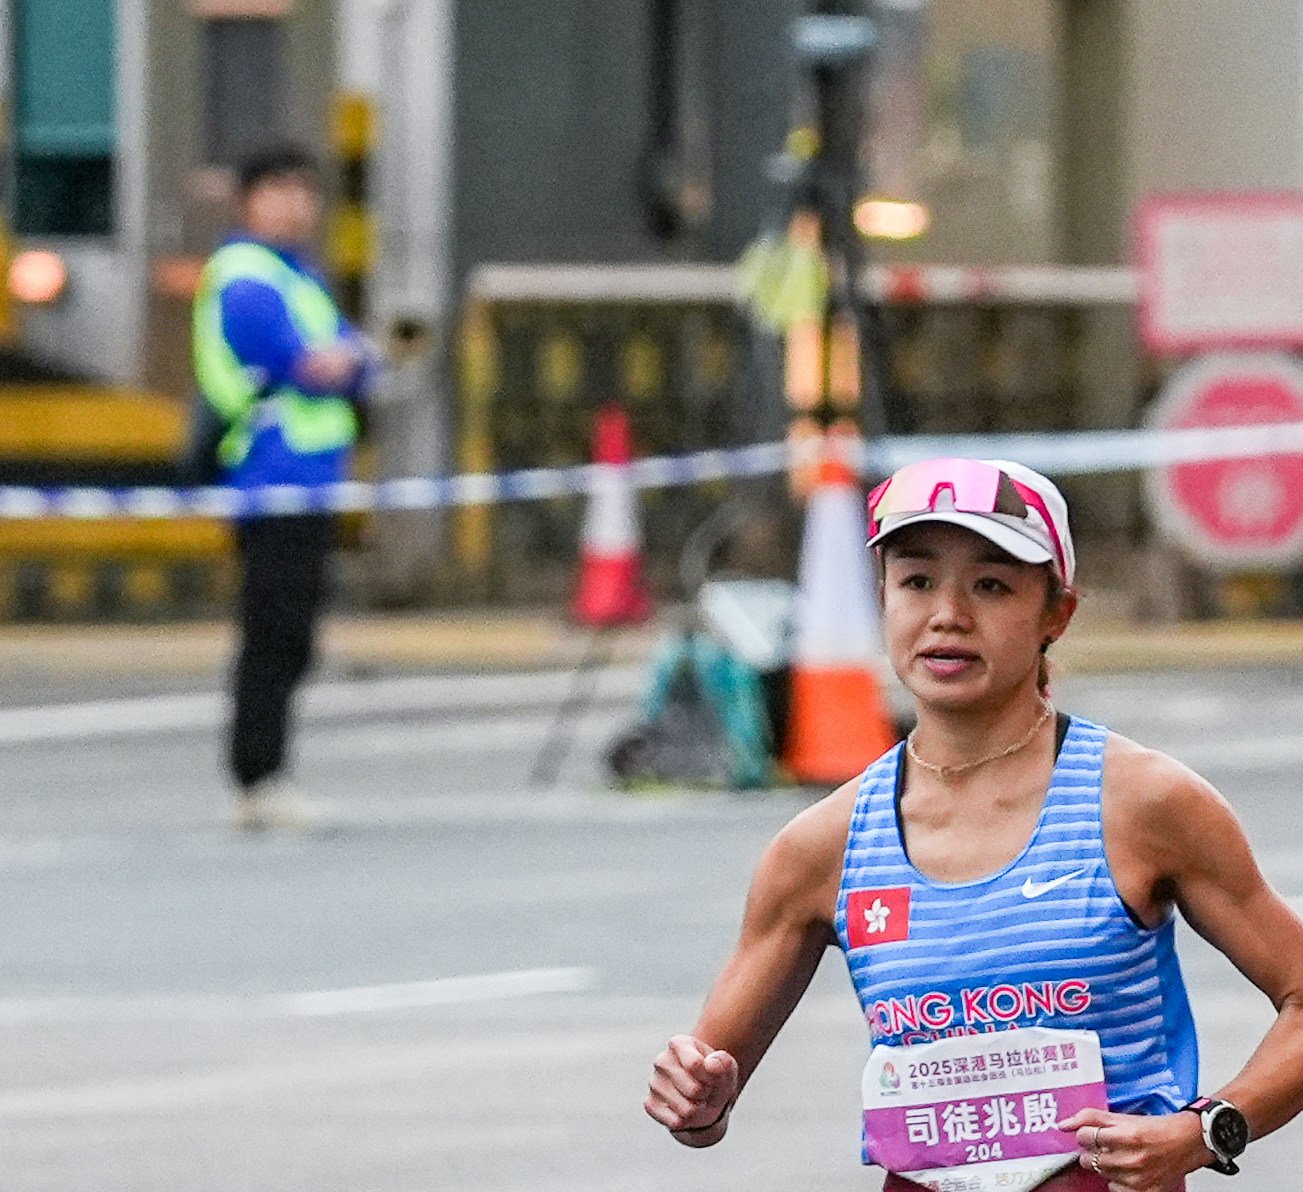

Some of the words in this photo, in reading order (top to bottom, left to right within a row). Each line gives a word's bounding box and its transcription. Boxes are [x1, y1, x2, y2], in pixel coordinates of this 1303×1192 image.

[962, 979, 1091, 1022] KONG
[905, 1093, 1059, 1146] 司徒兆殷
[965, 1142, 1003, 1162] 204
